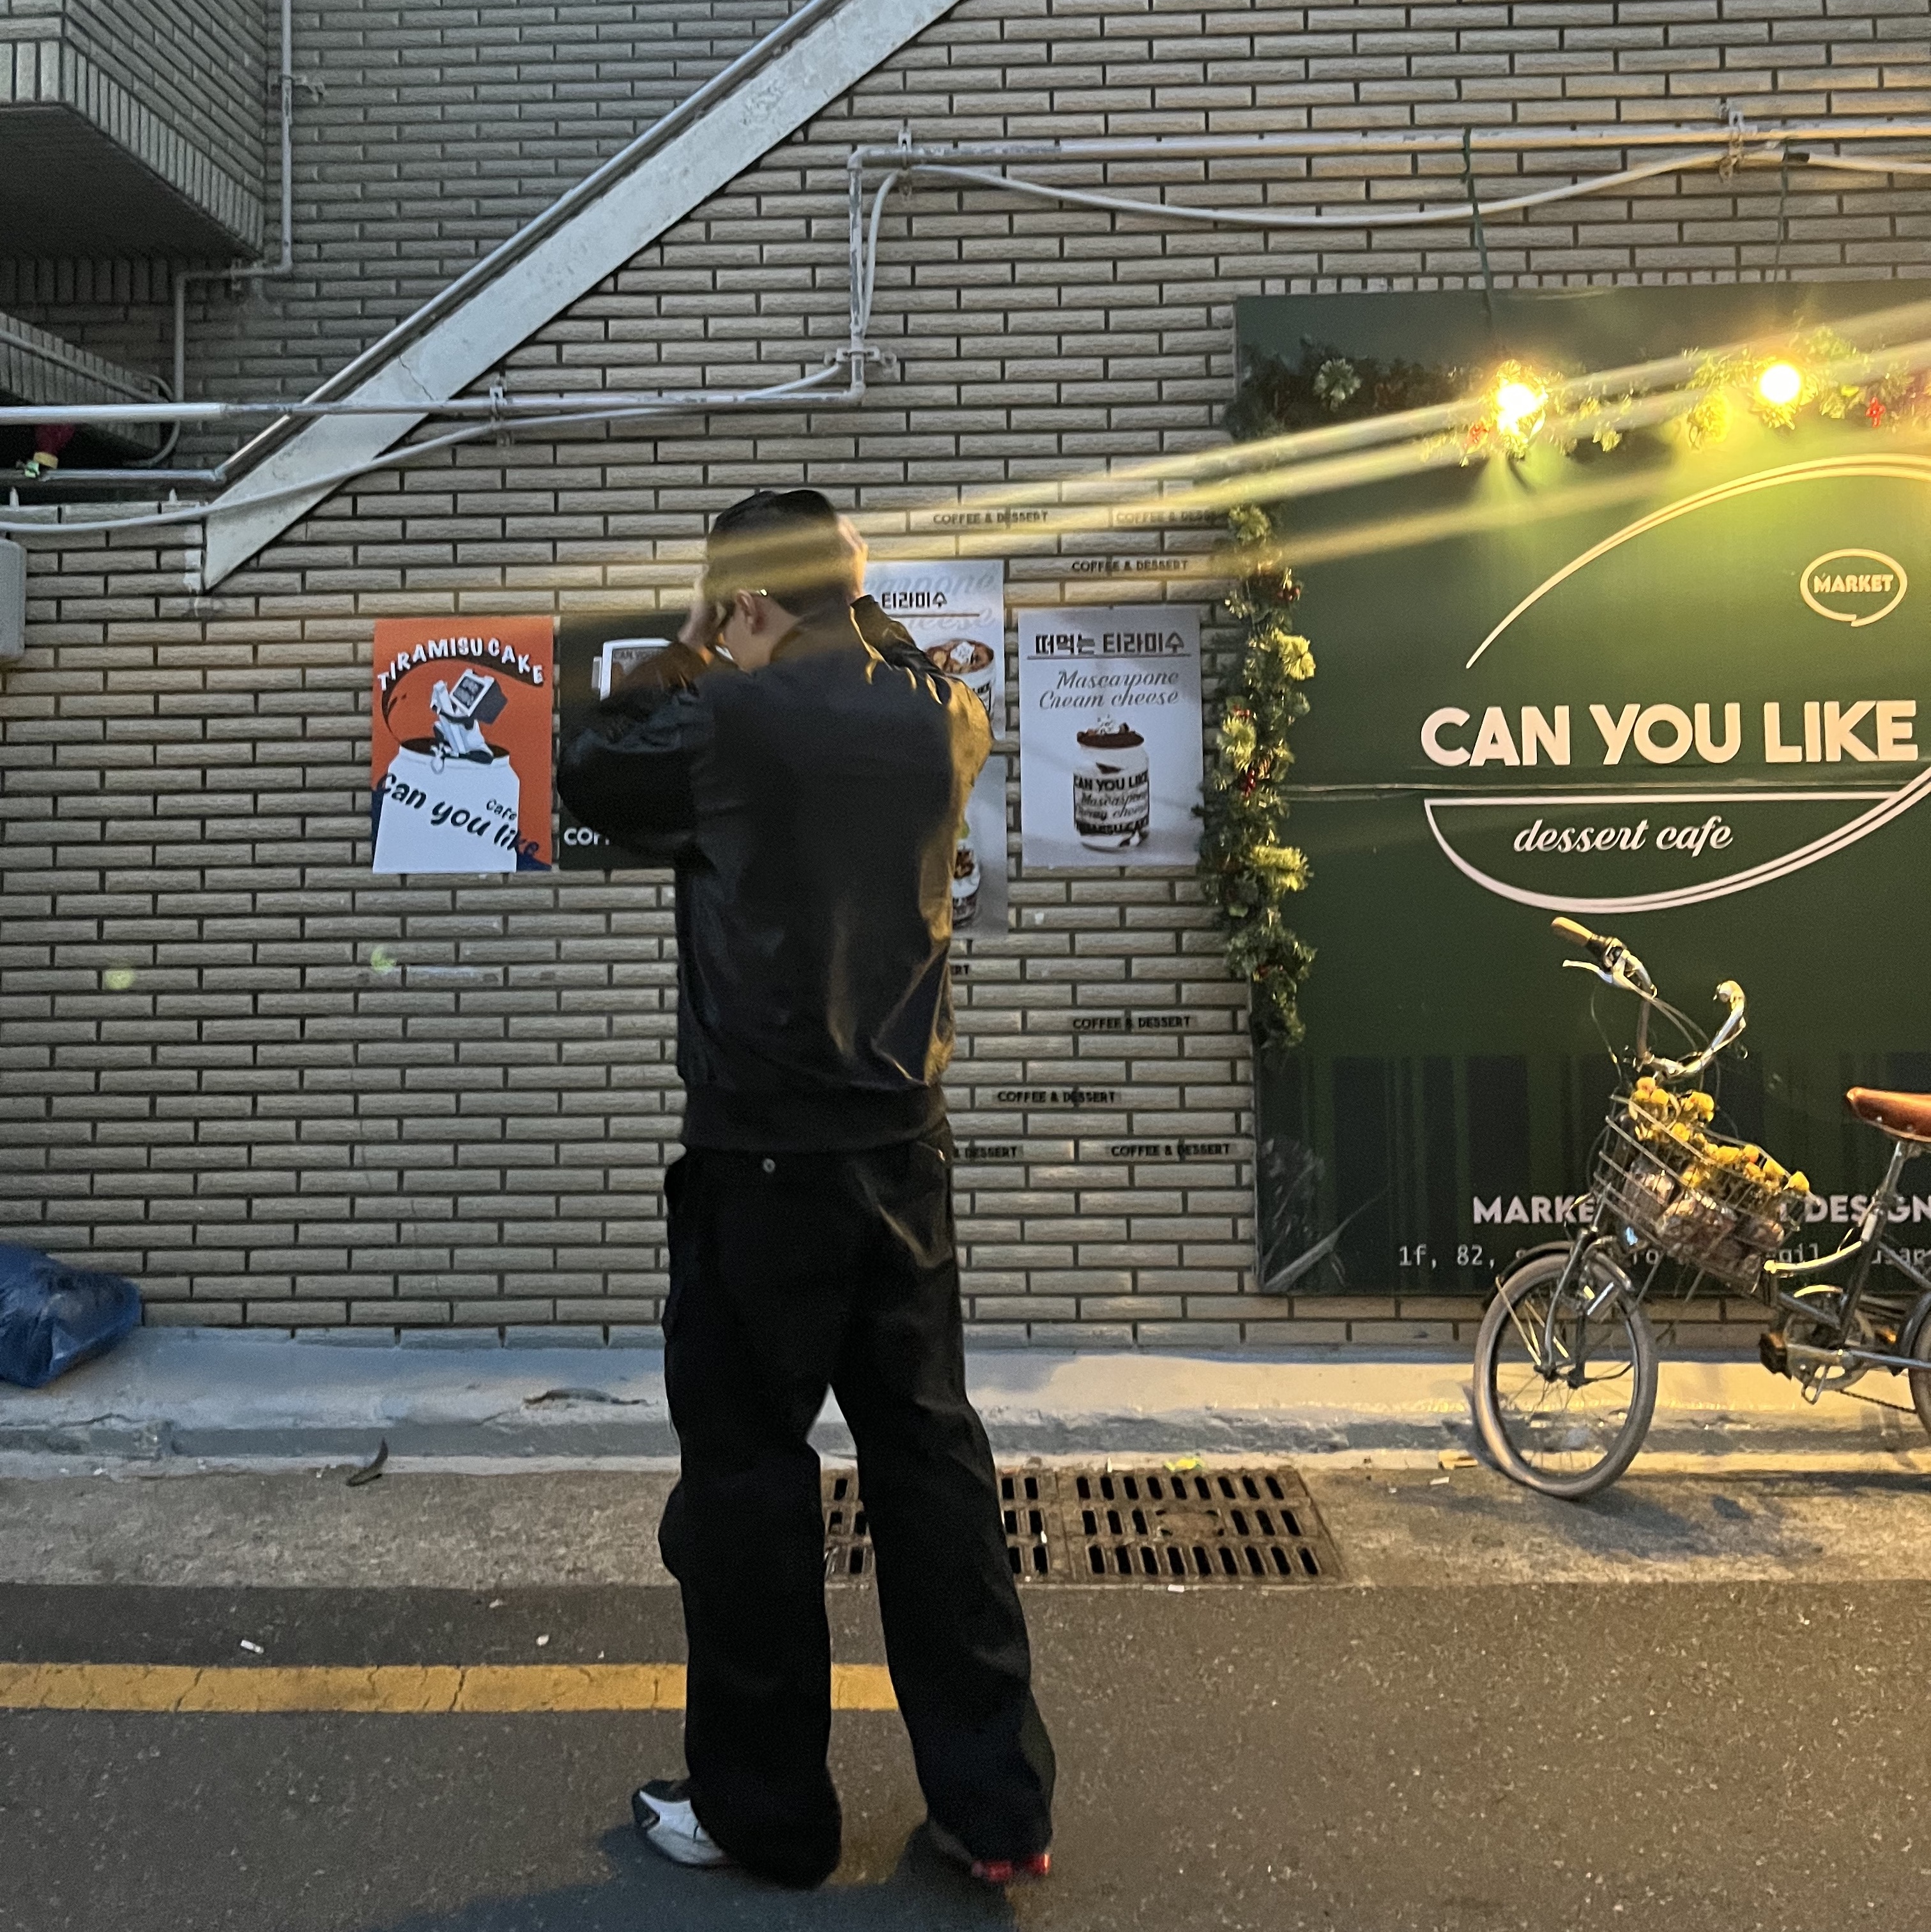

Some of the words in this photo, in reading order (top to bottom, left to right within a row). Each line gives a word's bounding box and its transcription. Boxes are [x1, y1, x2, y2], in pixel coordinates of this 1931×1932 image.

[933, 513, 981, 526] COFFEE
[985, 512, 993, 523] &
[996, 510, 1048, 523] DESSERT
[1071, 559, 1120, 572] COFFEE
[1124, 559, 1133, 571] &
[1136, 559, 1189, 572] DESSERT
[1813, 574, 1894, 593] MARKET
[882, 591, 947, 609] 티라미수
[1035, 632, 1095, 655] 떠먹는
[1103, 630, 1185, 653] 티라미수
[378, 637, 484, 691] TIRAMISU
[487, 637, 544, 685] CAKE
[1056, 669, 1179, 695] Mascarpone
[1039, 689, 1104, 710] Cream
[1111, 687, 1179, 707] cheese
[1420, 706, 1571, 767] CAN
[1589, 702, 1742, 766] YOU
[1763, 700, 1919, 763] LIKE
[1095, 777, 1126, 792] YOU
[431, 801, 491, 837] you
[494, 823, 540, 856] like
[1513, 819, 1650, 853] dessert
[1655, 815, 1734, 858] cafe
[1072, 1017, 1122, 1030] COFFEE
[1138, 1016, 1191, 1029] DESSERT
[997, 1091, 1046, 1104] COFFEE
[1050, 1091, 1058, 1103] &
[1063, 1091, 1116, 1104] DESSERT
[1111, 1145, 1161, 1157] COFFEE
[1164, 1145, 1173, 1156] &
[1398, 1244, 1438, 1269] 1f,
[1456, 1244, 1495, 1270] 82,
